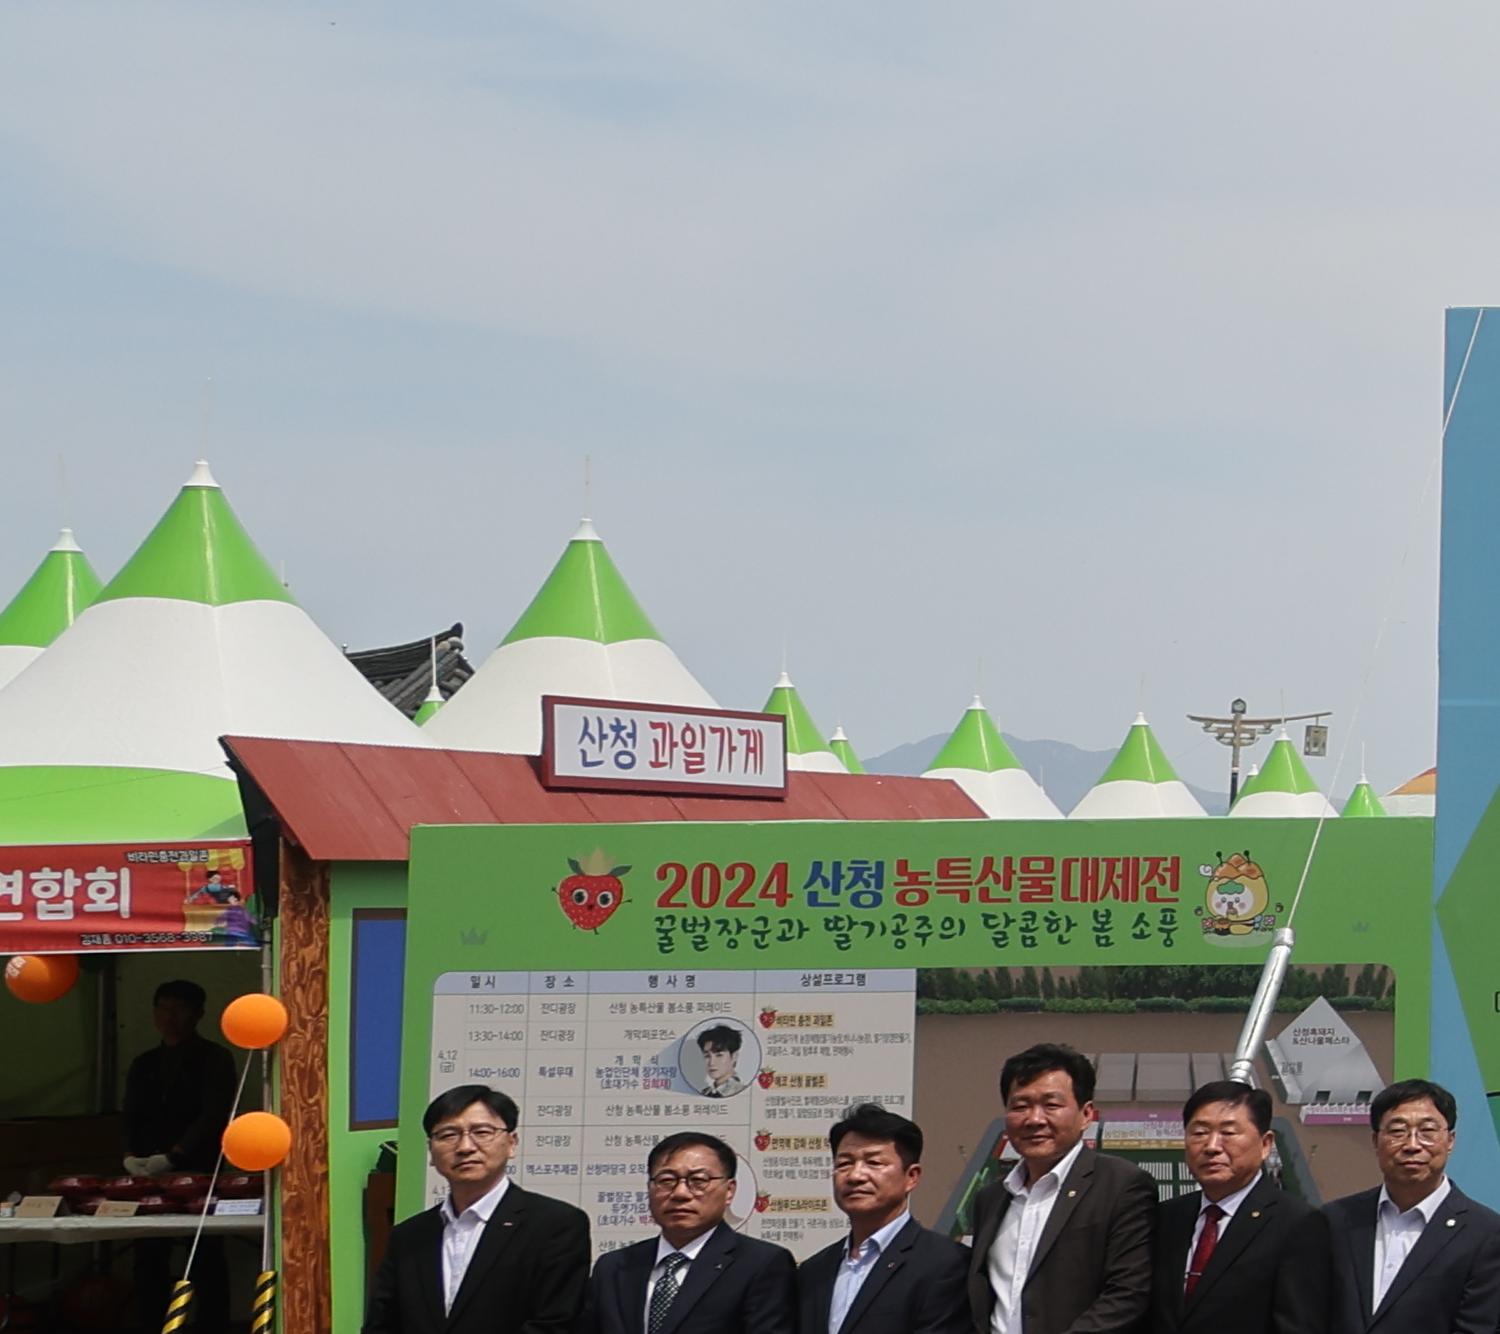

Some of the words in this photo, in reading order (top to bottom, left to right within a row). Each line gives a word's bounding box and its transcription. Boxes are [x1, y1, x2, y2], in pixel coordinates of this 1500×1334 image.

[577, 715, 638, 770] 산청
[648, 720, 764, 775] 과일가게
[656, 861, 794, 909] 2024
[803, 859, 885, 909] 산청
[654, 913, 810, 955] 꿀벌장군과
[823, 912, 966, 952] 딸기공주의
[981, 909, 1078, 949] 달콤한
[1092, 908, 1115, 948] 봄
[1131, 907, 1179, 948] 소풍
[801, 973, 867, 987] 상설프로그램
[540, 1002, 576, 1015] 잔디광장
[609, 1002, 628, 1014] 산청
[630, 1002, 665, 1014] 농특산물
[540, 1030, 575, 1042] 잔디광장
[437, 1049, 458, 1061] 4.12
[537, 1104, 572, 1116] 잔디광장
[605, 1104, 623, 1116] 산청
[626, 1104, 660, 1116] 농특산물
[535, 1135, 571, 1147] 잔디광장
[604, 1135, 622, 1147] 산청
